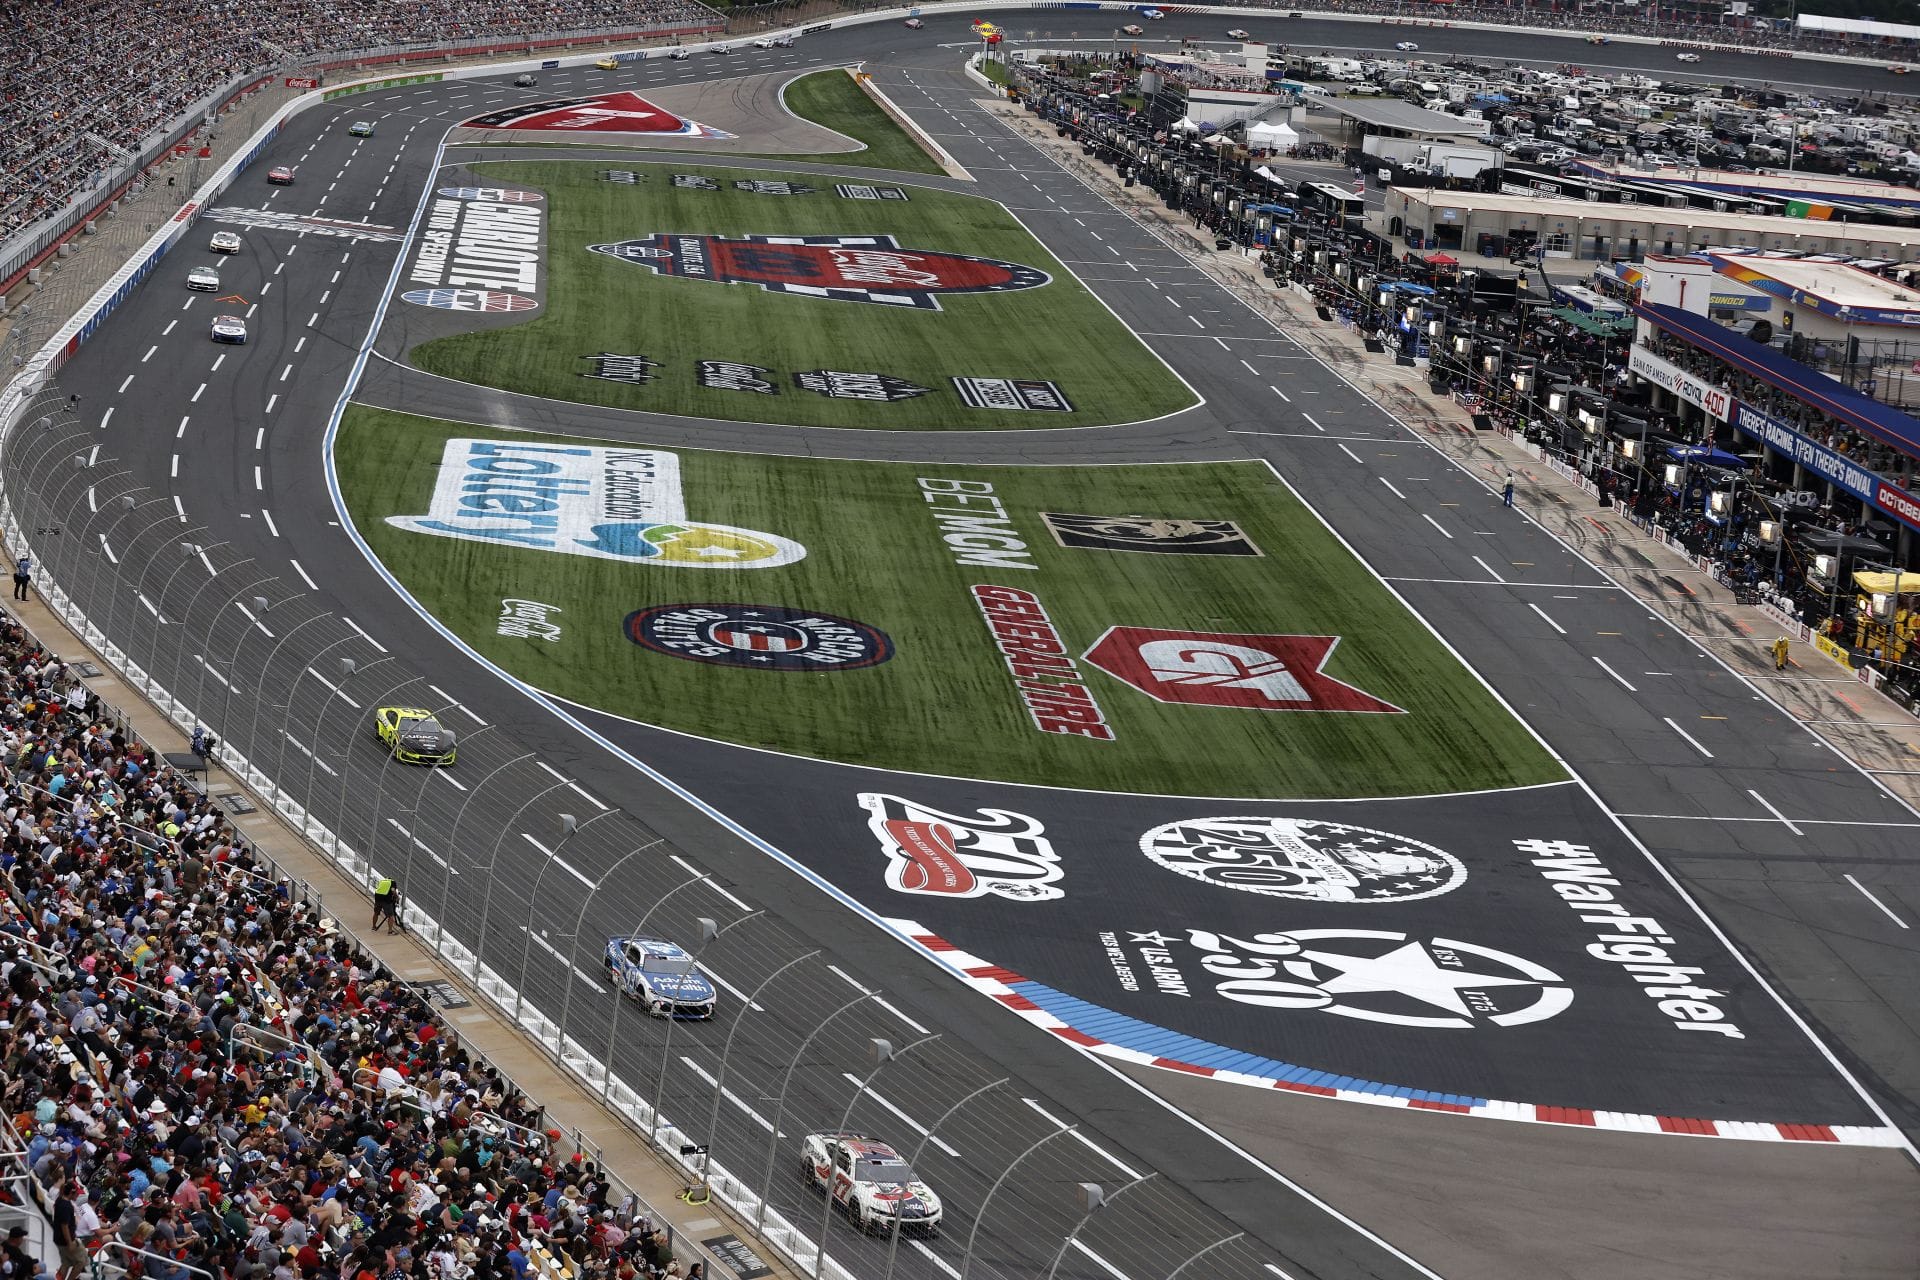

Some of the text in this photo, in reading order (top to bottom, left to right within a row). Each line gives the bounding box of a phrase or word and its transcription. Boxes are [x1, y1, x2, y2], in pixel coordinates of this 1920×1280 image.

[289, 78, 311, 88] Coca-Cola
[410, 199, 462, 286] MOTOR SPEEDWAY
[450, 201, 541, 293] CHARLOTTE
[828, 249, 944, 288] Coca-Cola
[1710, 296, 1746, 306] SUNOCO
[580, 352, 658, 385] xfinity
[701, 361, 772, 393] Coca-Cola
[799, 374, 829, 391] LIGHT
[823, 372, 888, 401] BUSCH
[1633, 357, 1673, 387] BANK OF AMERICA
[1704, 390, 1725, 416] 400
[1739, 407, 1766, 436] THERE'S
[1765, 421, 1794, 456] RACING,
[1795, 438, 1814, 464] THEN
[1814, 449, 1846, 482] THERE'S
[414, 442, 592, 548] Lottery
[604, 451, 656, 520] NC Education
[1879, 488, 1920, 521] OCTOBE
[917, 477, 1038, 570] BETMGM
[497, 598, 562, 642] Coca-Cola
[652, 608, 731, 657] SALUTES
[786, 617, 866, 664] NASCAR
[970, 584, 1116, 742] GENERAL TIRE
[903, 826, 957, 888] UNITED STATES MARINE CORPS
[1178, 826, 1305, 887] 250
[1271, 832, 1352, 882] AMERICA'S NAVY
[1431, 949, 1464, 968] EST
[1512, 838, 1746, 1039] #WarFighter
[653, 975, 703, 986] Advent
[1099, 931, 1140, 992] THIS WE'LL DEFEND
[1139, 947, 1192, 998] U.S. ARMY
[1184, 928, 1333, 1010] 250
[659, 983, 707, 993] Health
[1461, 990, 1499, 1012] 1775
[833, 1173, 853, 1202] 77
